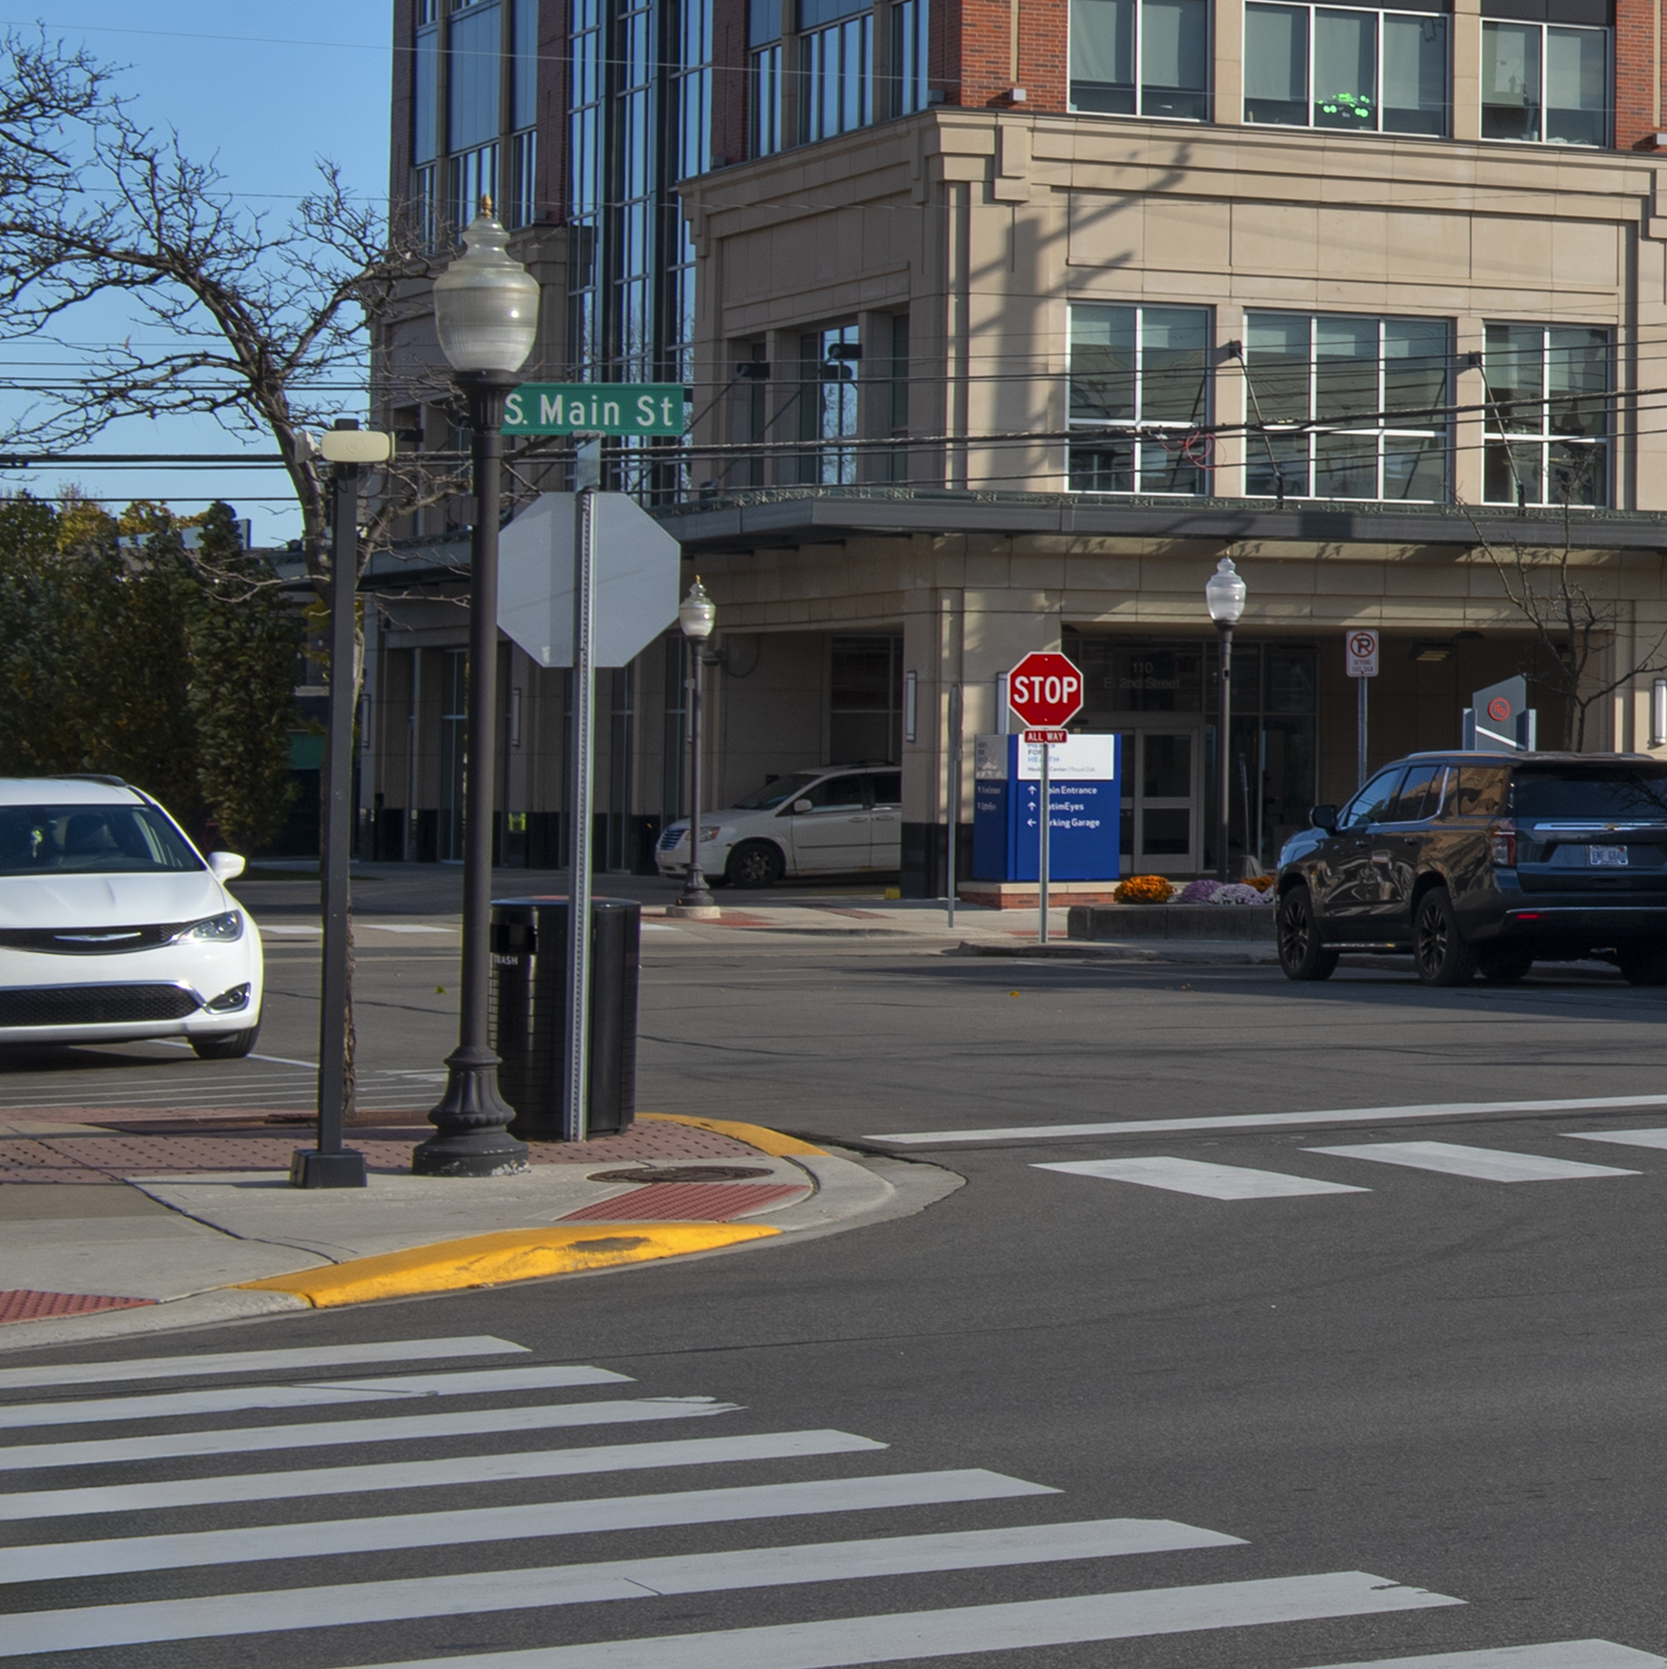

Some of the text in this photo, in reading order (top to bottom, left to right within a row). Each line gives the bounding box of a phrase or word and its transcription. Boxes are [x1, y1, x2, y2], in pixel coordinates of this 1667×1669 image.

[504, 393, 673, 426] S. Main St
[1133, 662, 1153, 674] 110
[1119, 677, 1142, 689] 2nd
[1145, 677, 1180, 689] Street
[1013, 675, 1078, 704] STOP
[1027, 733, 1064, 742] ALL WAY
[1061, 786, 1098, 795] Entrance
[1049, 818, 1101, 829] rking Garage
